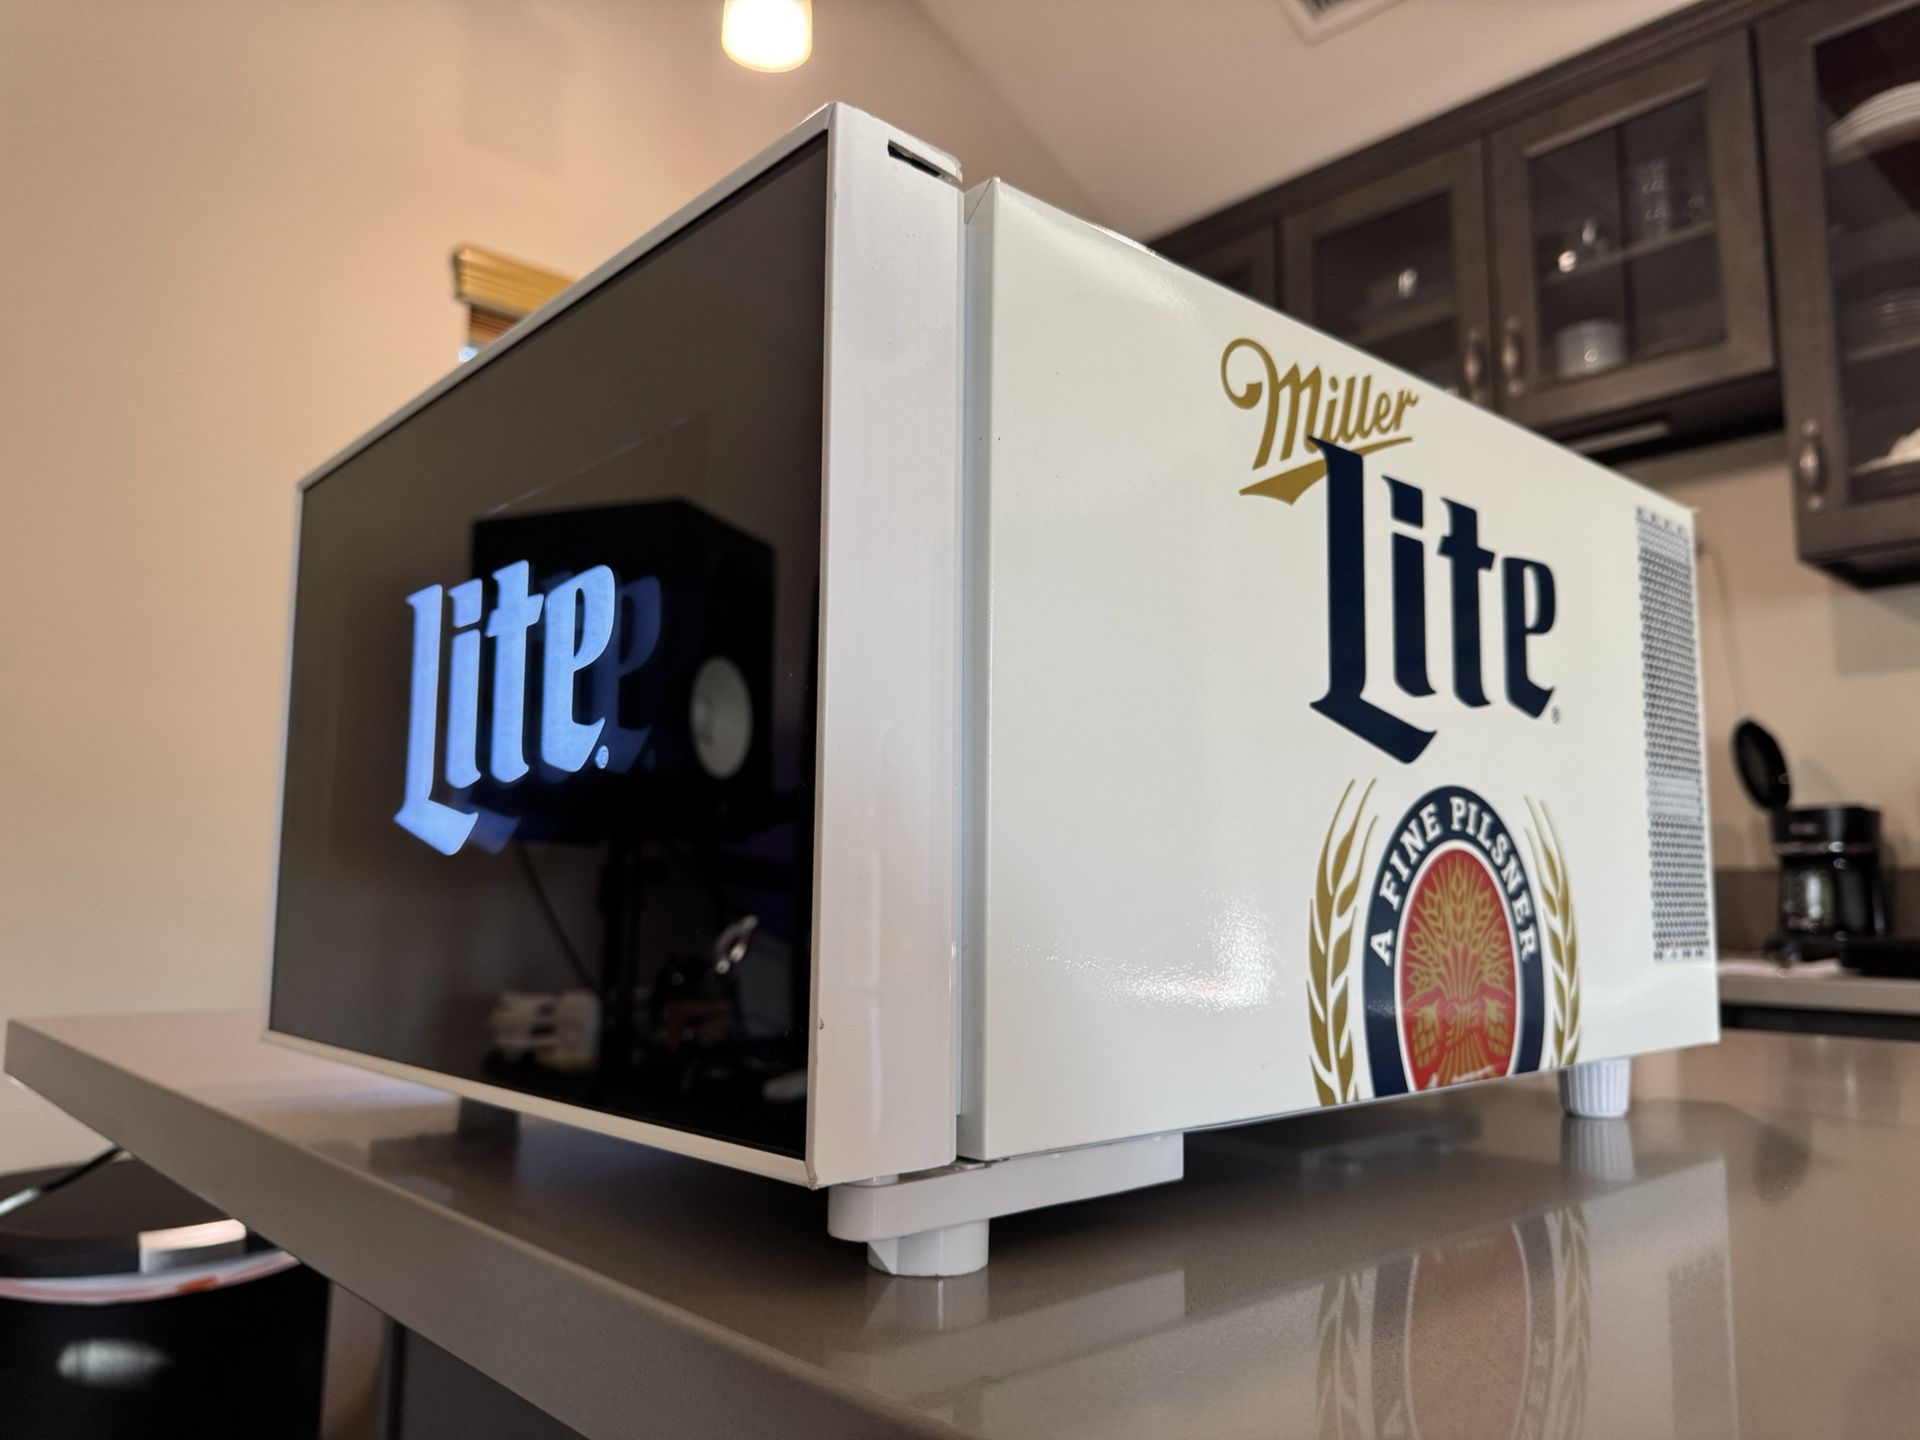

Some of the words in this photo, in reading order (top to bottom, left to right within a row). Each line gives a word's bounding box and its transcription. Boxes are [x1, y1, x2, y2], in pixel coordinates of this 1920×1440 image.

[1221, 338, 1418, 472] Miller
[1307, 436, 1556, 764] Lite
[393, 559, 614, 856] Lite
[1379, 803, 1444, 911] FINE
[1450, 796, 1538, 961] PILSNER
[1370, 928, 1394, 967] A
